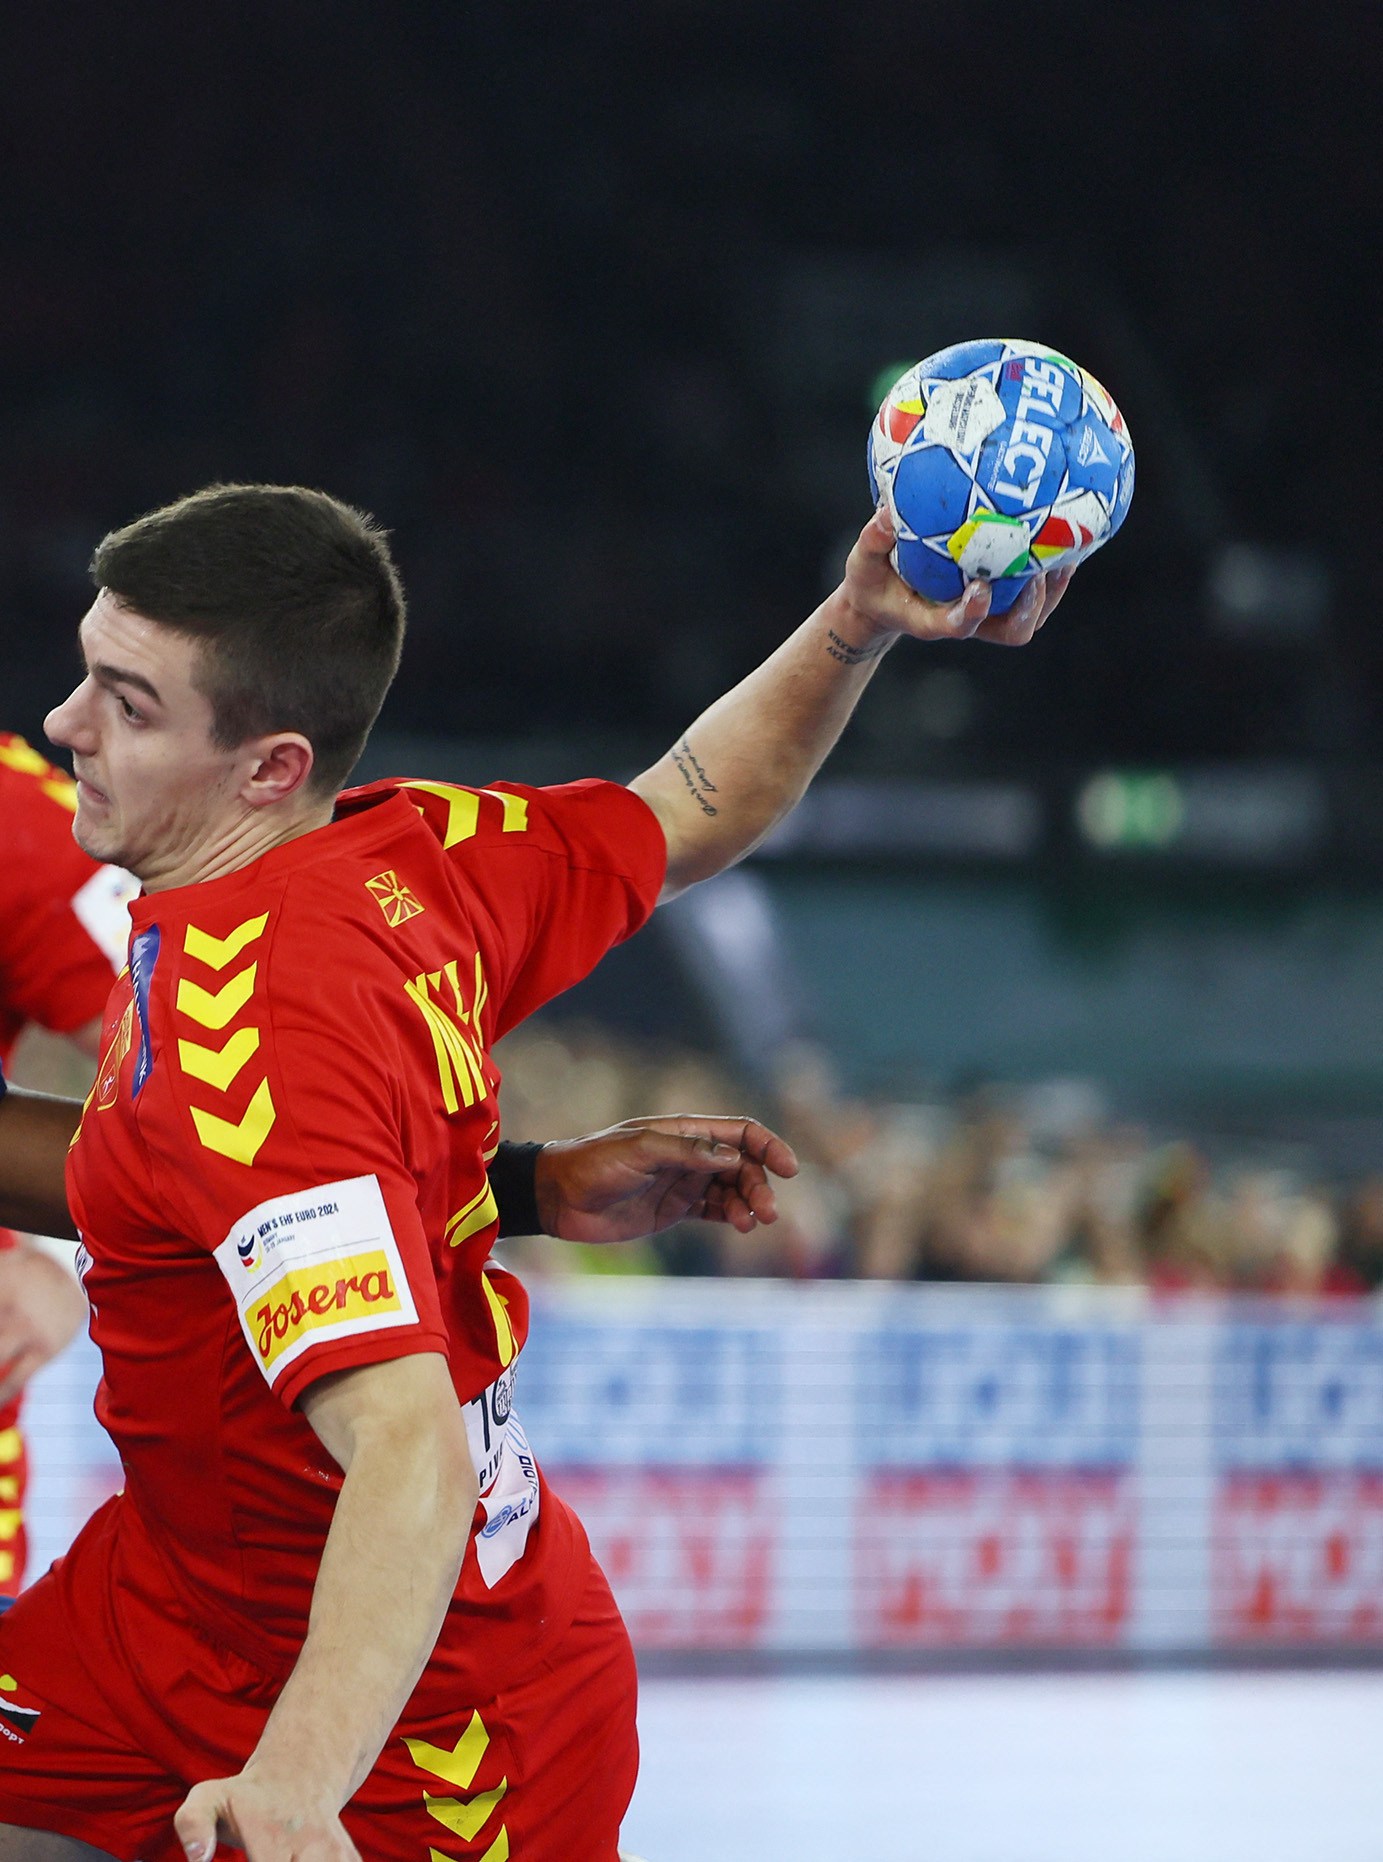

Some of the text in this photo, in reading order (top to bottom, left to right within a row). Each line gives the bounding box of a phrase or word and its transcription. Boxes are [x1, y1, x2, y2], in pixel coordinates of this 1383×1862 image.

[995, 357, 1065, 508] SELECT
[257, 1202, 340, 1238] MEN'S EHF EURO 2024
[257, 1270, 394, 1358] Josera
